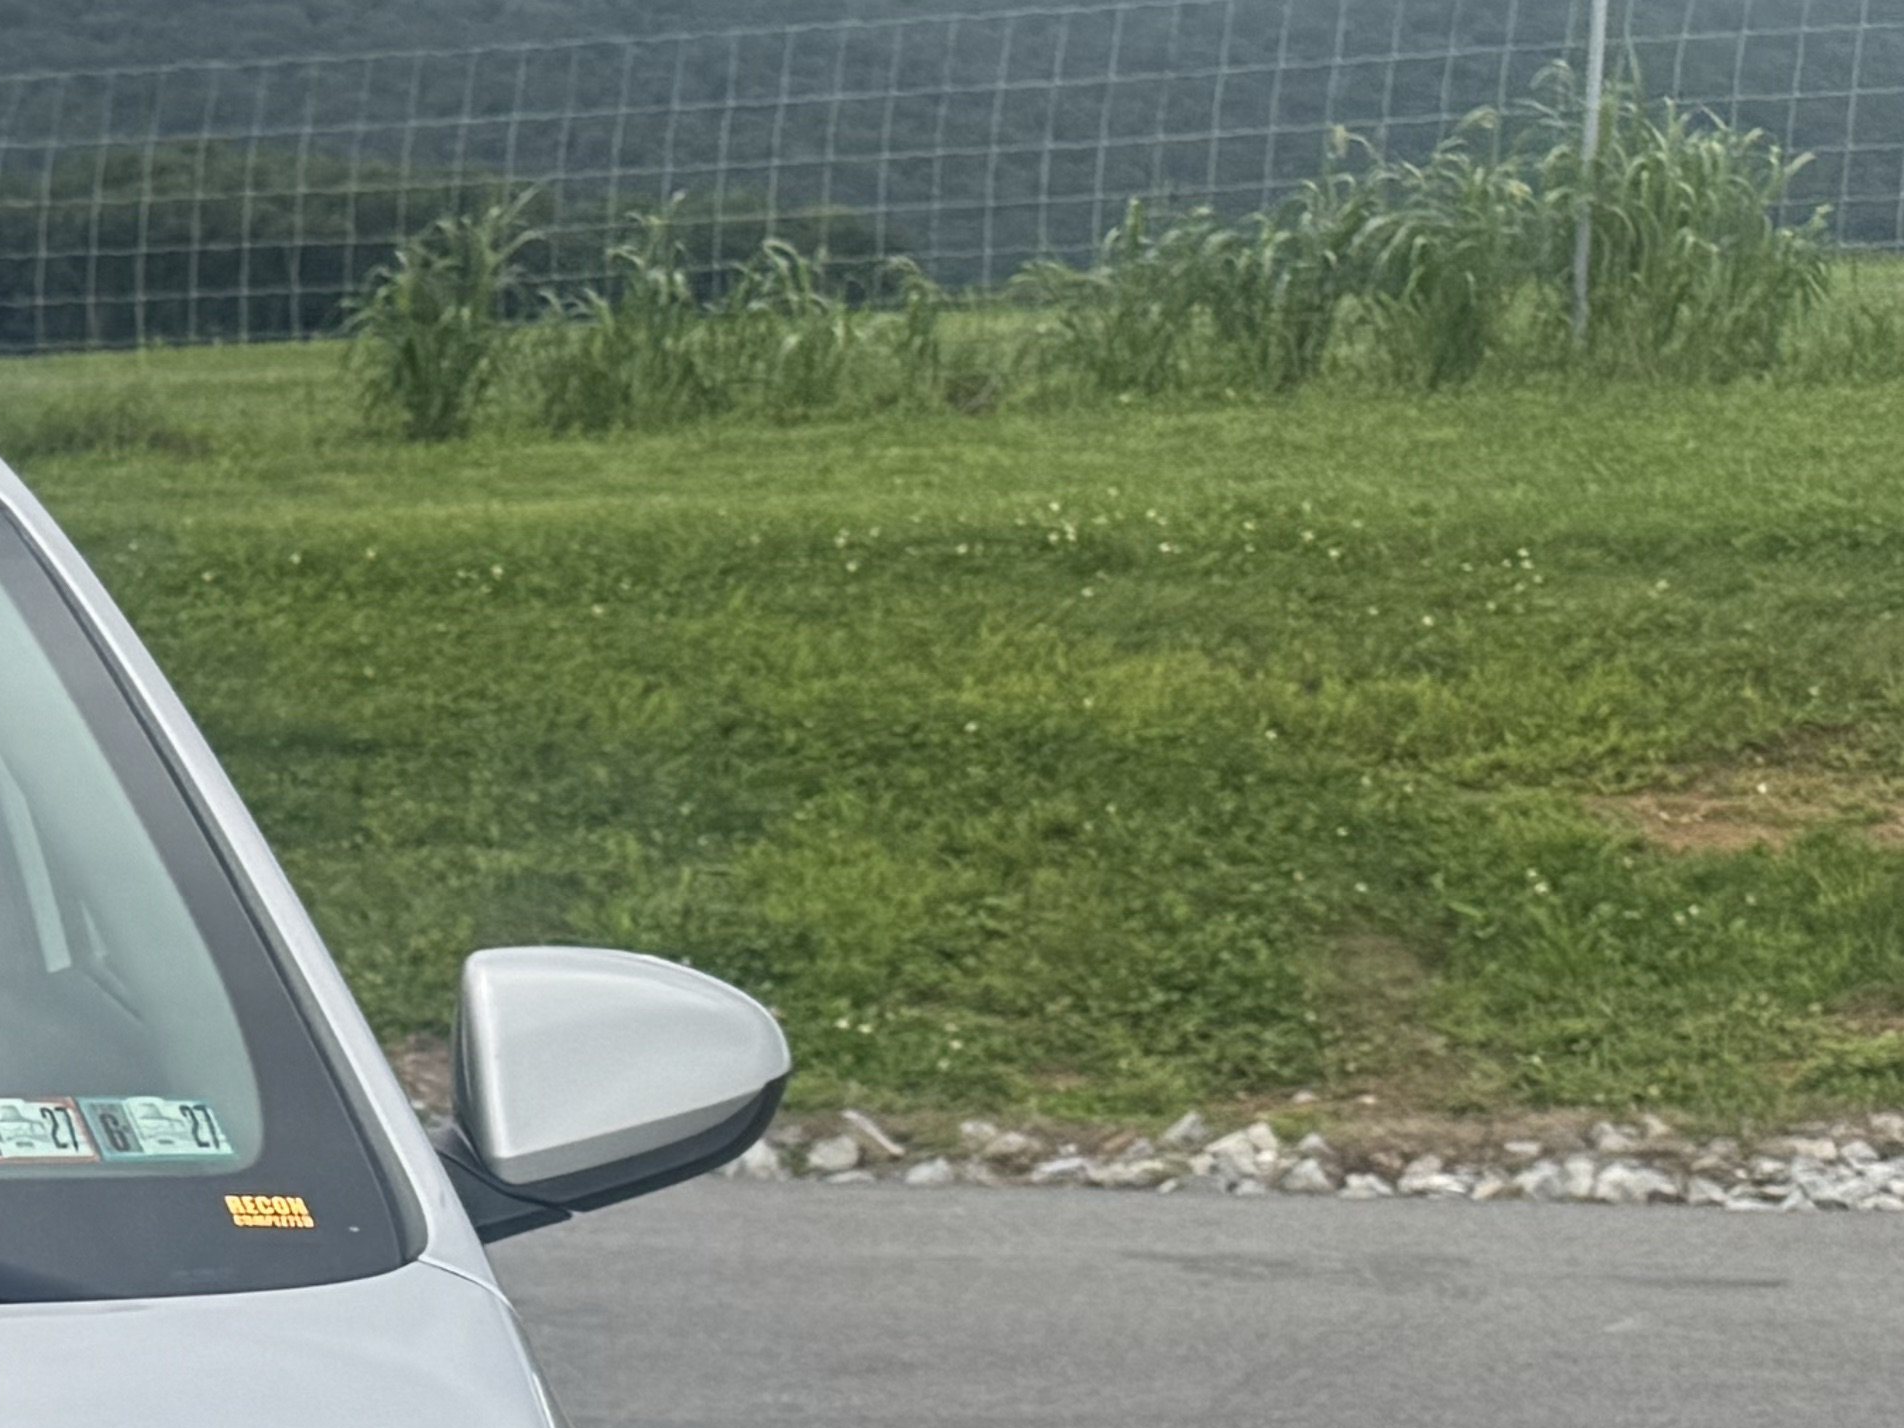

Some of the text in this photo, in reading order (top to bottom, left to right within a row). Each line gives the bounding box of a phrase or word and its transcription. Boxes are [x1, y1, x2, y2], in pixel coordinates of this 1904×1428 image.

[39, 1106, 79, 1152] 27
[179, 1104, 221, 1149] 27
[223, 1194, 310, 1216] RECON
